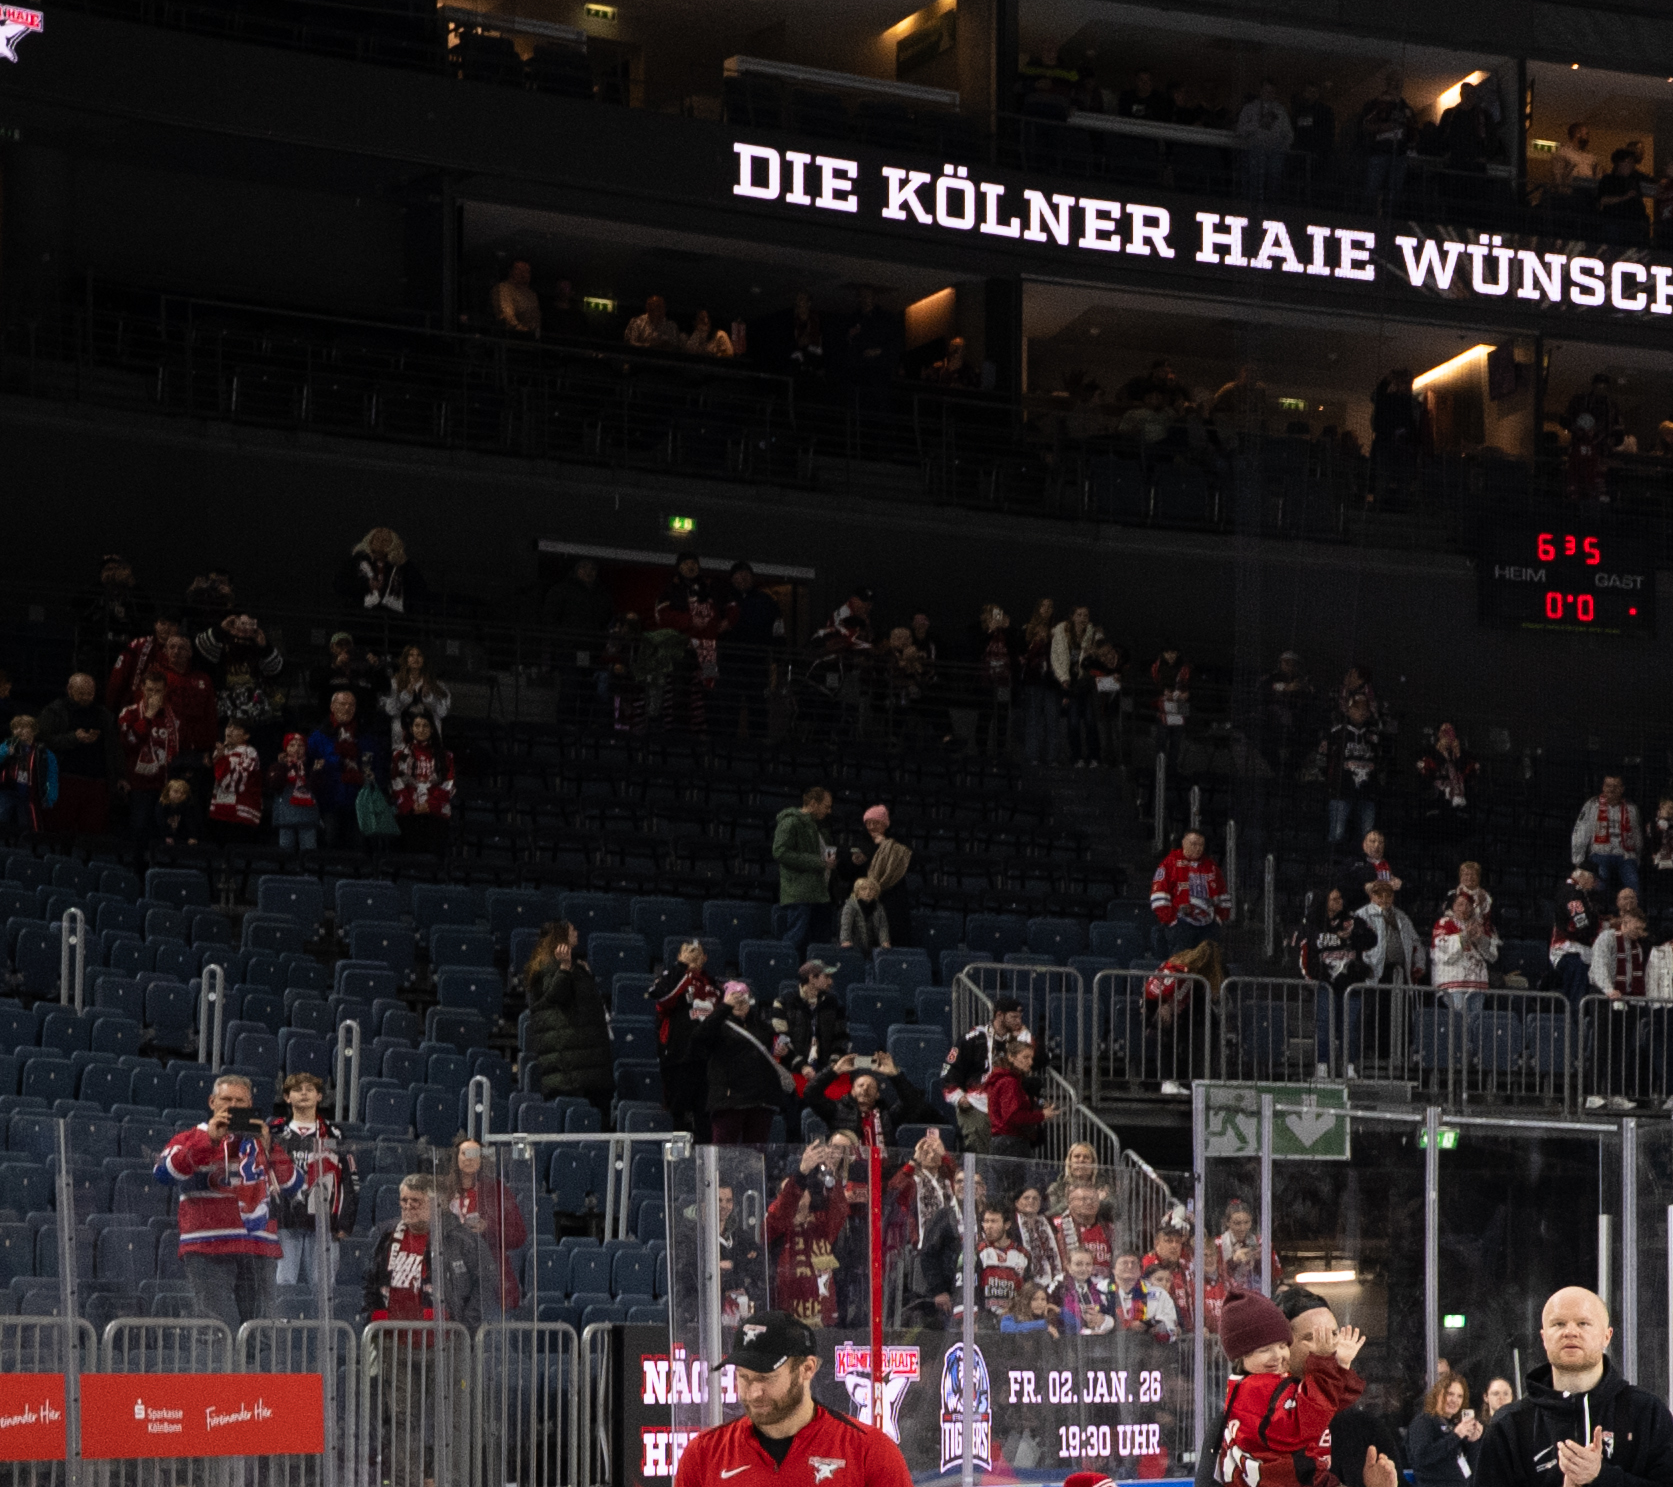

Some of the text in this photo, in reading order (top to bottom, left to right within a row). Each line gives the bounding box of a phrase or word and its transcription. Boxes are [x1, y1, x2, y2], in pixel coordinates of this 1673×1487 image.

[734, 143, 857, 212] DIE
[882, 164, 1174, 258] KÖLNER
[1196, 212, 1374, 280] HAIE
[1537, 532, 1556, 561] 6
[1583, 536, 1600, 565] 5
[1494, 565, 1645, 590] HEIM GAST
[1008, 1370, 1162, 1404] FR. 02. JAN. 26
[147, 1408, 183, 1420] Sparkasse
[147, 1422, 183, 1433] KölnBonn
[1059, 1423, 1161, 1458] 19:30 UHR
